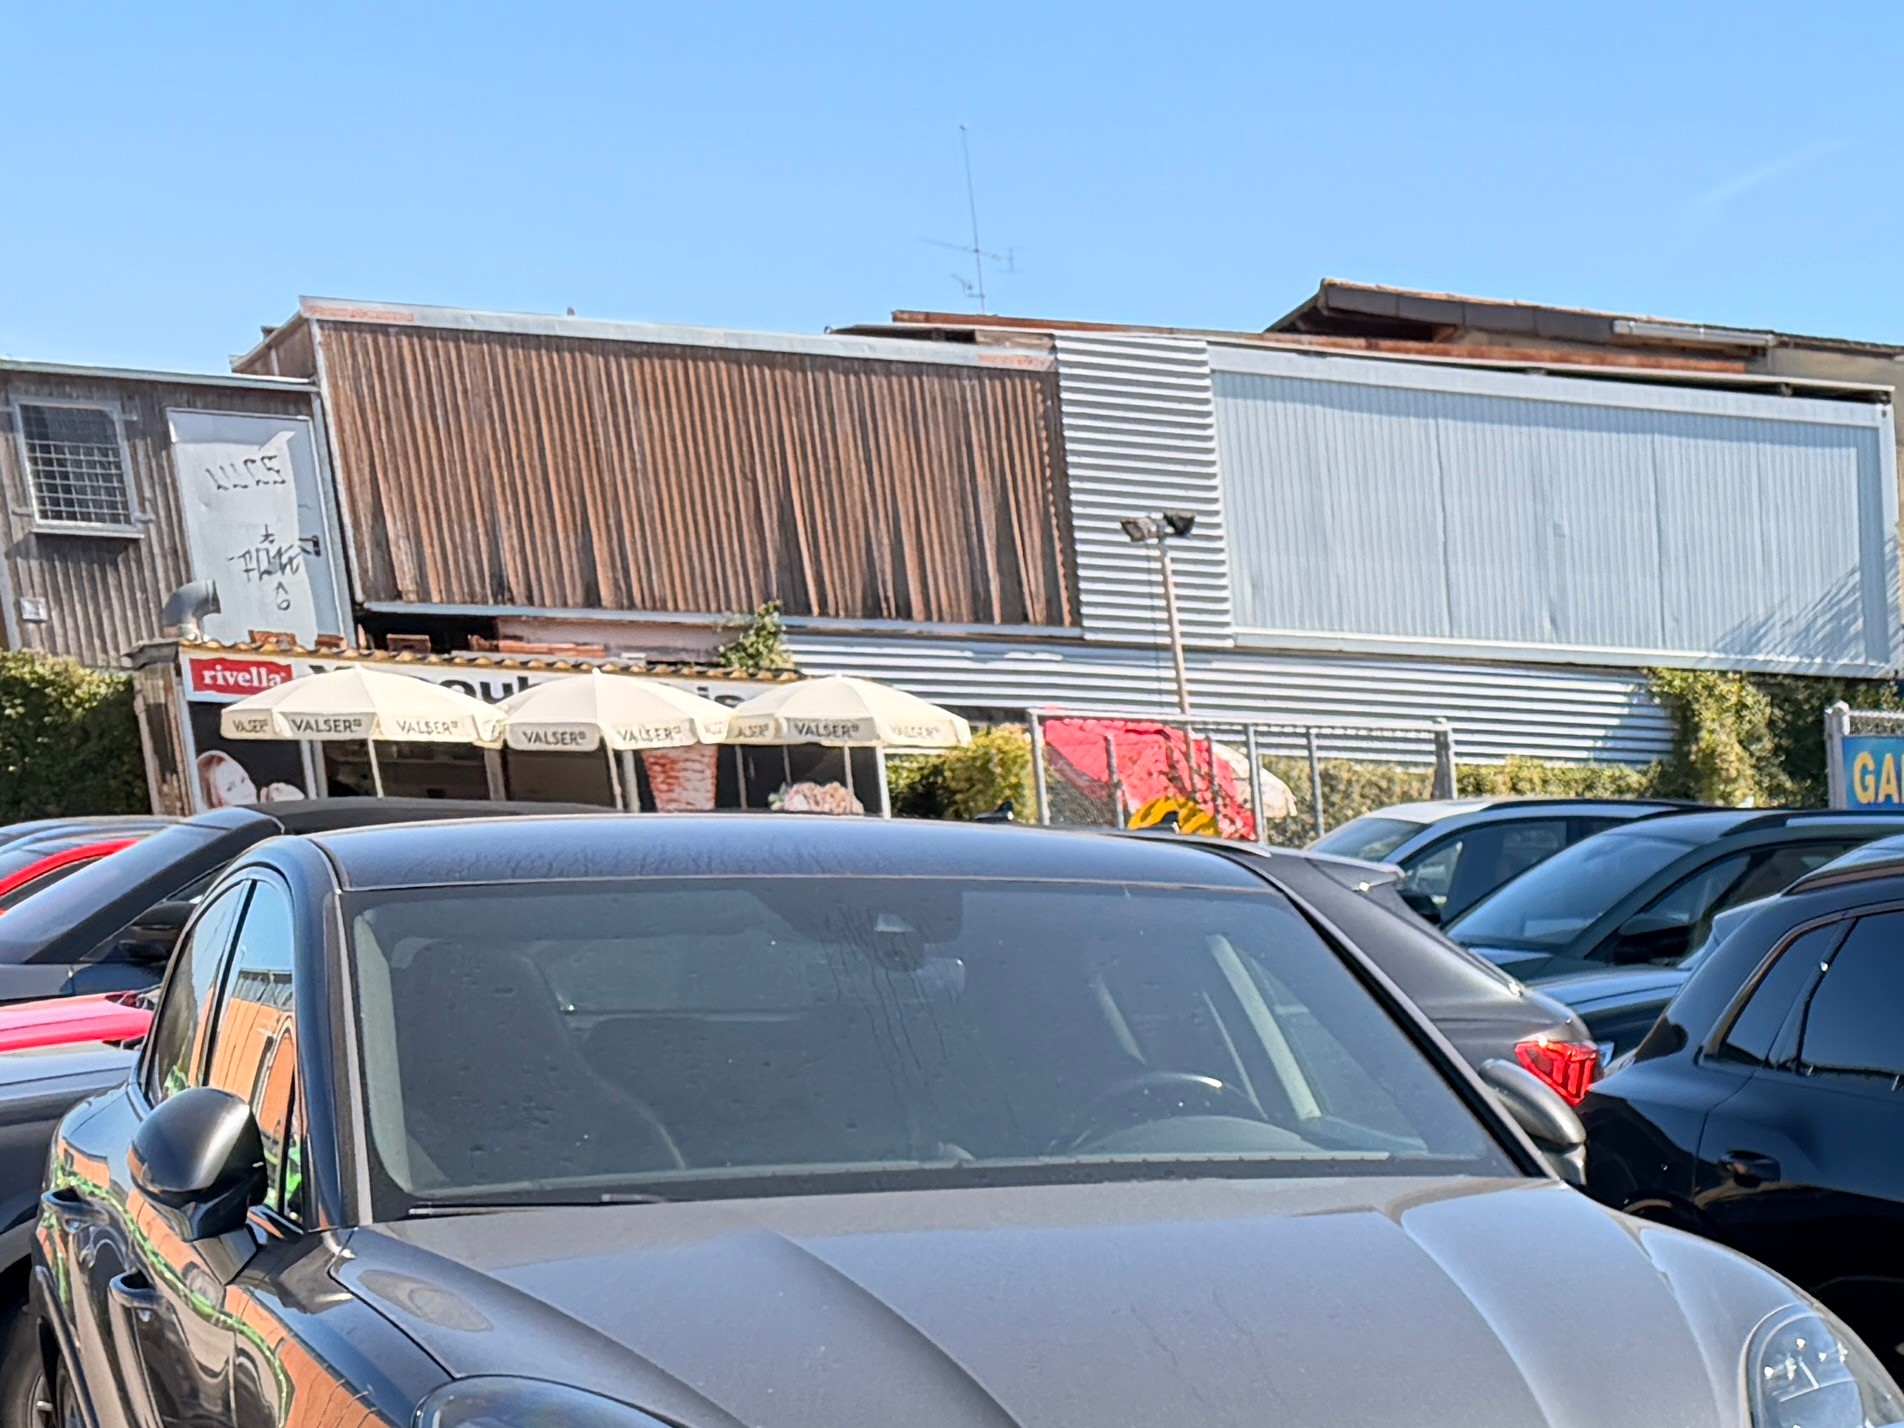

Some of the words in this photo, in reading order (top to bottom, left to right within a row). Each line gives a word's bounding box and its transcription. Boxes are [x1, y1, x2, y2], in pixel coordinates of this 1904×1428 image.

[202, 664, 283, 688] rivella
[291, 718, 353, 734] VALSER
[794, 722, 849, 737] VALSER
[522, 730, 580, 746] VALSER
